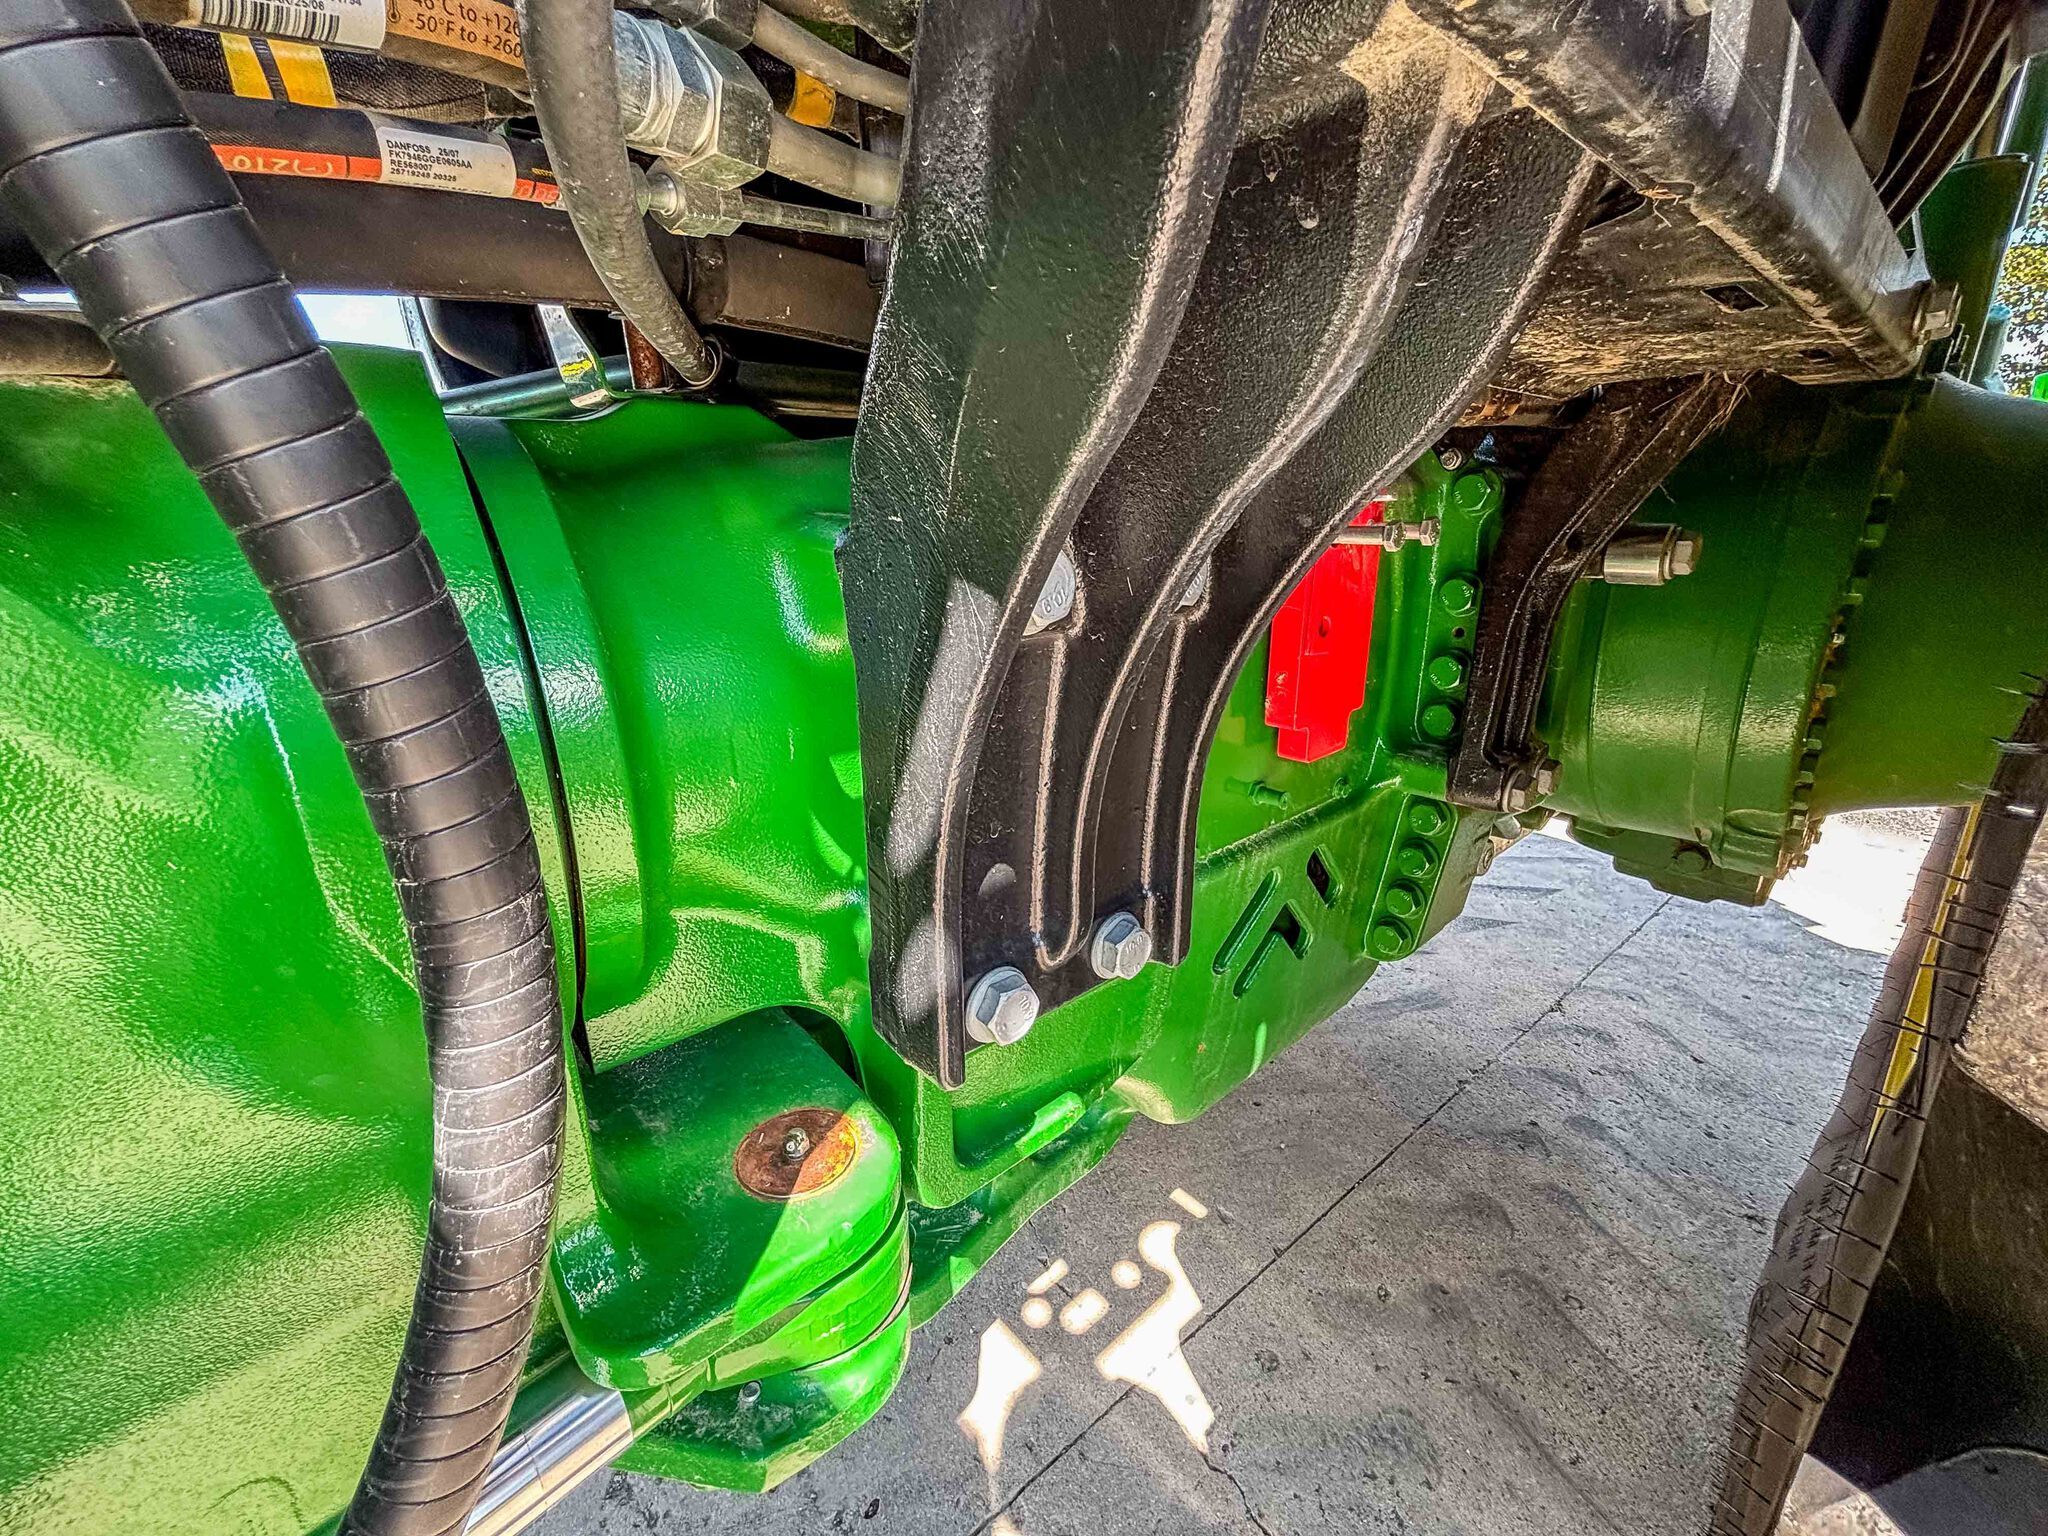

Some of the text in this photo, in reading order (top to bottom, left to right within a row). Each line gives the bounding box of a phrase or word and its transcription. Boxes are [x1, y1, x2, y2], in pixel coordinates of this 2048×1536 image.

[459, 3, 477, 22] to
[409, 13, 522, 57] -50°F to +260
[386, 139, 431, 154] DANFOSS
